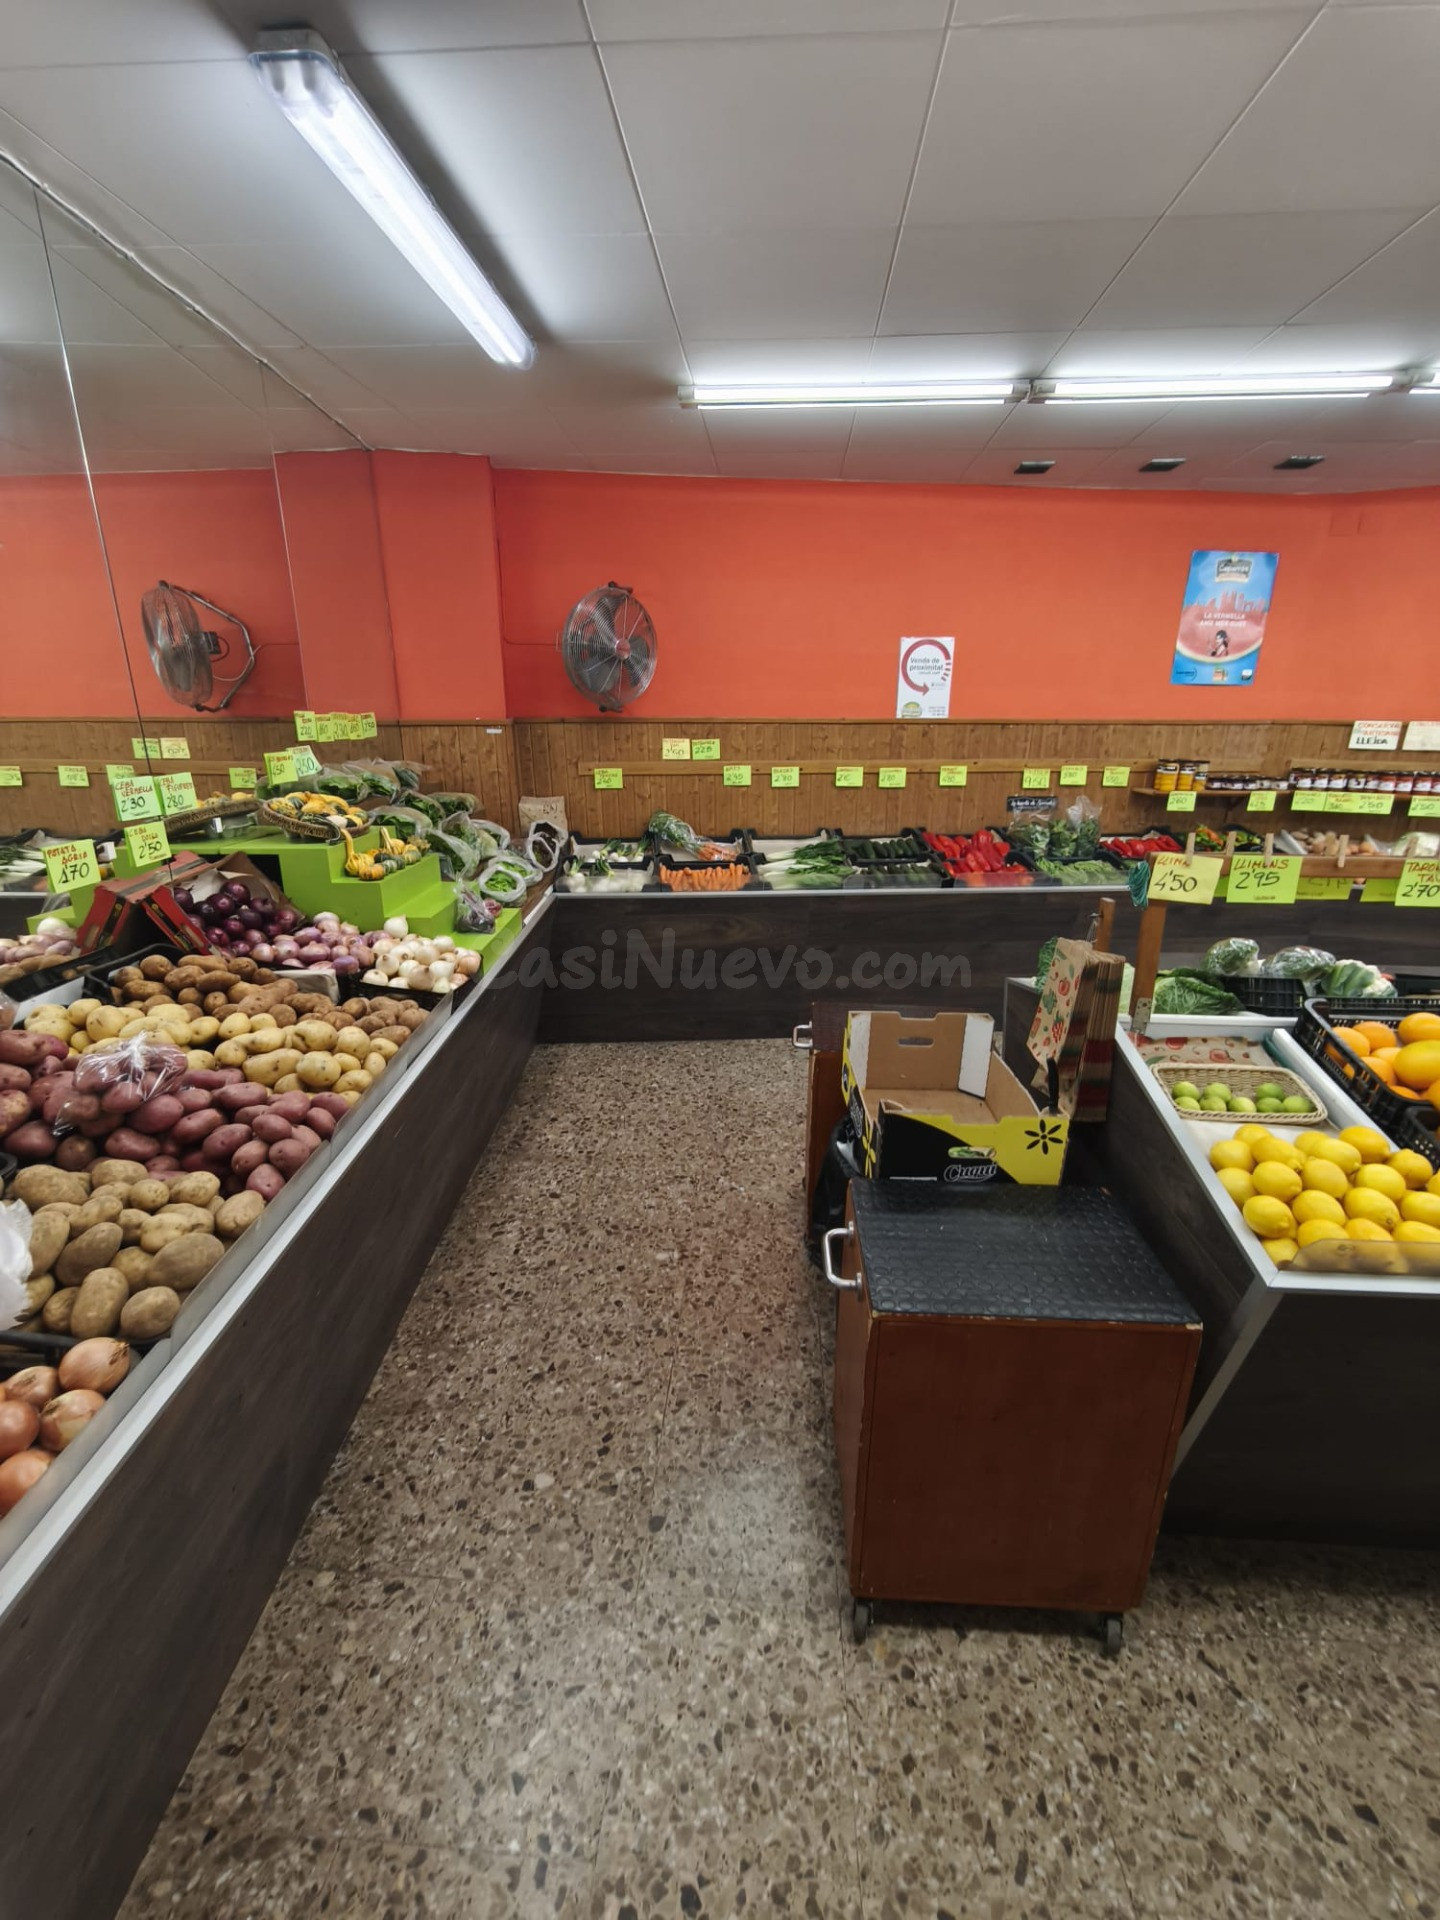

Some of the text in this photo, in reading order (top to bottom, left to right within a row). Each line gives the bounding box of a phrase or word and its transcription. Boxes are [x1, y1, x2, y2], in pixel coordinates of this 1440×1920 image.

[909, 664, 944, 672] proximitat
[121, 784, 153, 797] VERMELLA
[121, 796, 146, 813] 2'30
[46, 844, 77, 860] PATATA
[61, 851, 88, 865] AGRIA
[138, 841, 162, 859] 2'50
[1154, 869, 1198, 893] 4'50
[1235, 869, 1280, 890] 2'95
[1401, 882, 1440, 899] 2'70
